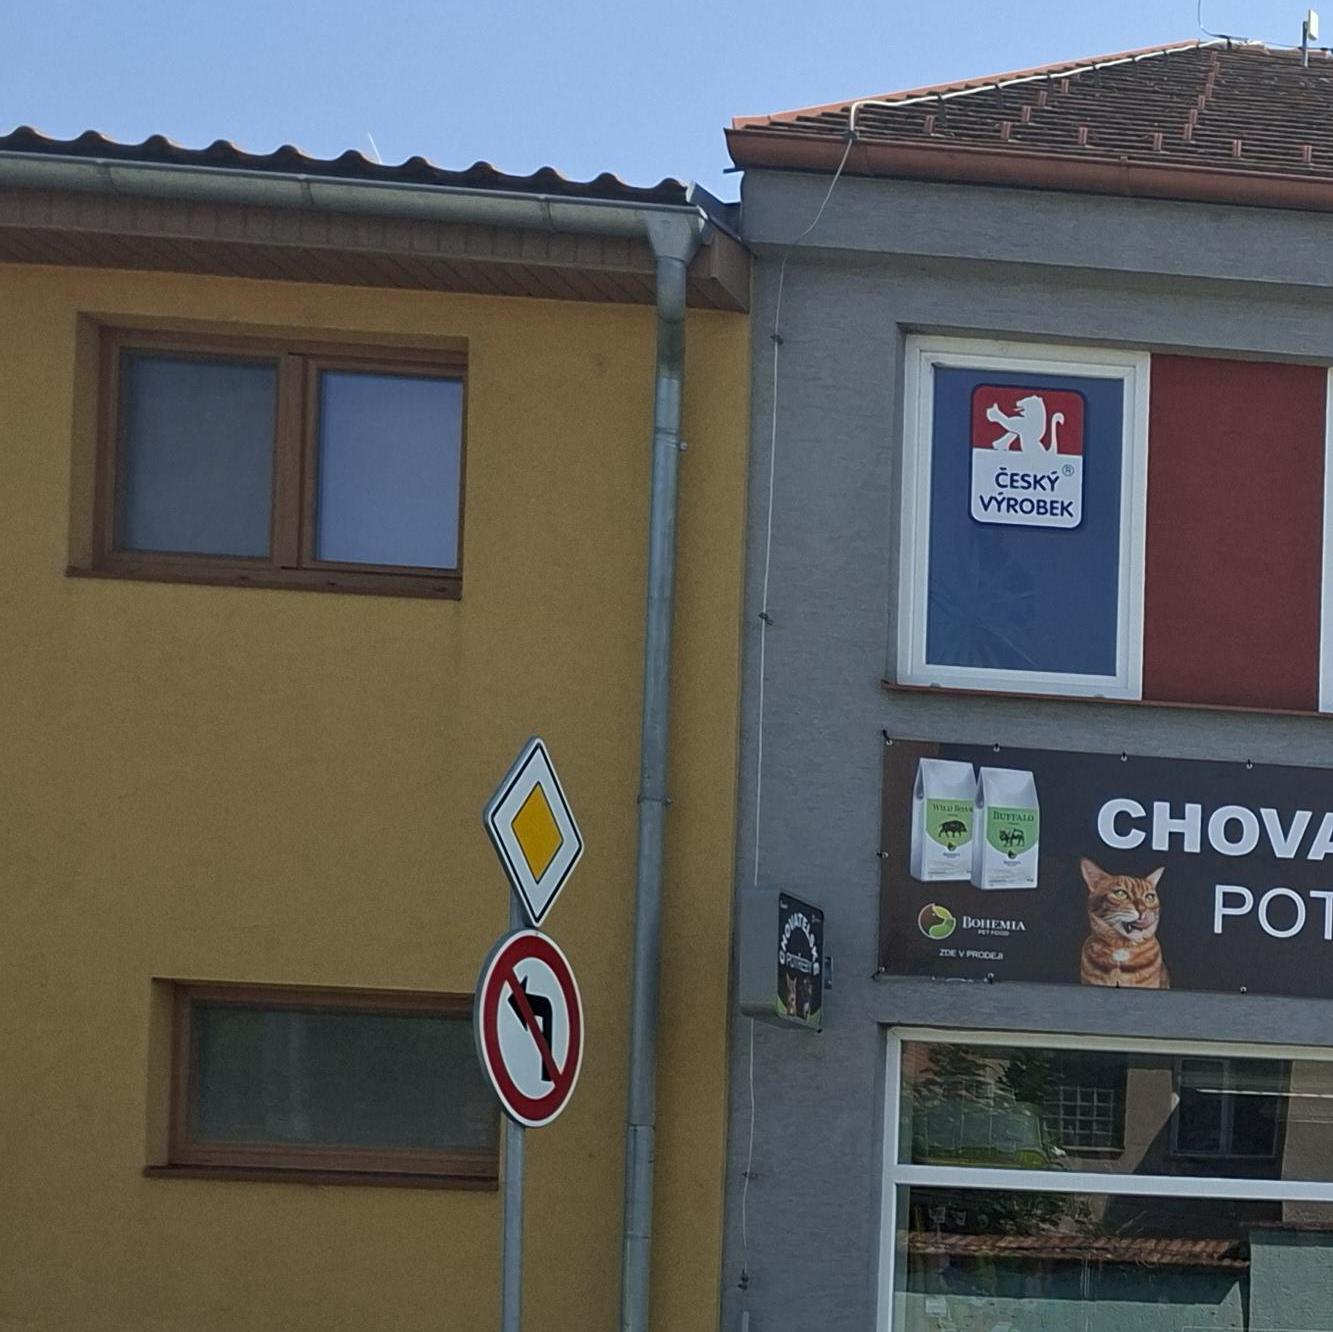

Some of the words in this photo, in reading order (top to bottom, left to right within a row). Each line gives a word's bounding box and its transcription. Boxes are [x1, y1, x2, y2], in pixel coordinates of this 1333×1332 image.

[994, 466, 1060, 493] ČESKÝ
[979, 492, 1074, 518] VÝROBEK
[962, 916, 1026, 931] BOHEMIA
